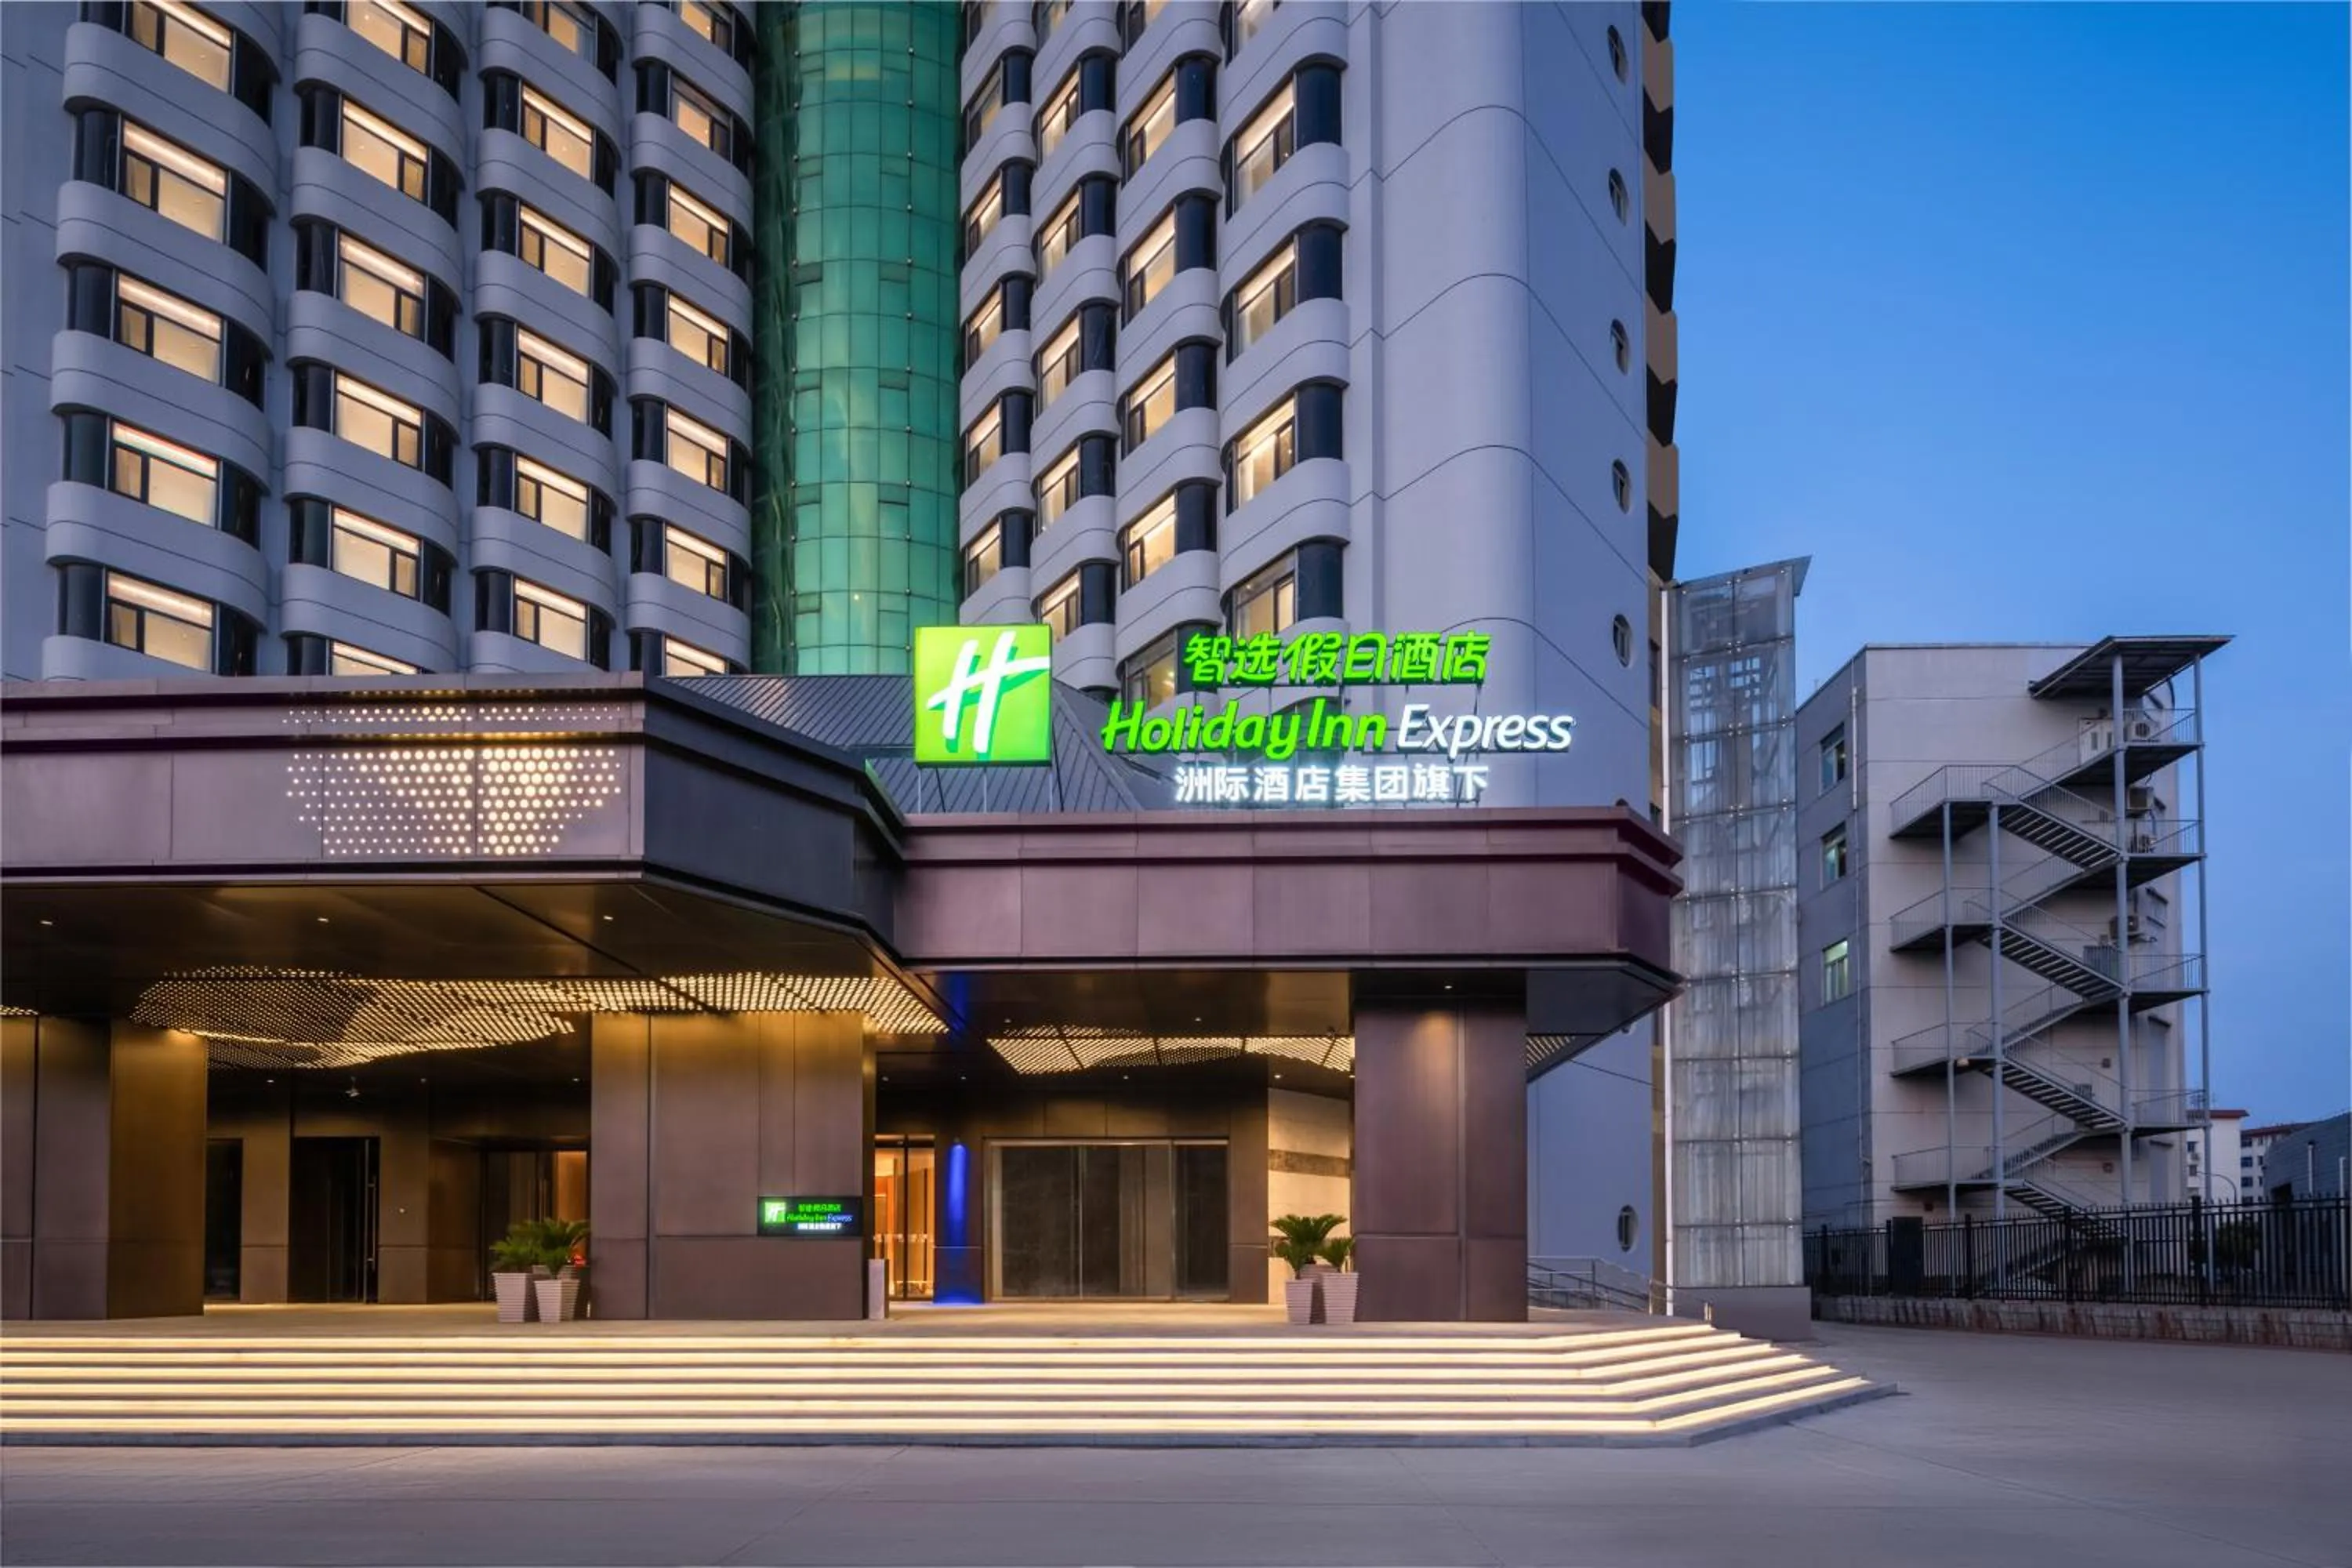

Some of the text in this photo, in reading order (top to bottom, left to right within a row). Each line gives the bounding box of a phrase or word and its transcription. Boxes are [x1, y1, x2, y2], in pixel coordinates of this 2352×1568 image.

[1184, 631, 1493, 685] 智选假日酒店
[1102, 697, 1574, 760] Holiday Inn Express
[1174, 763, 1490, 802] 洲际酒店集团旗下
